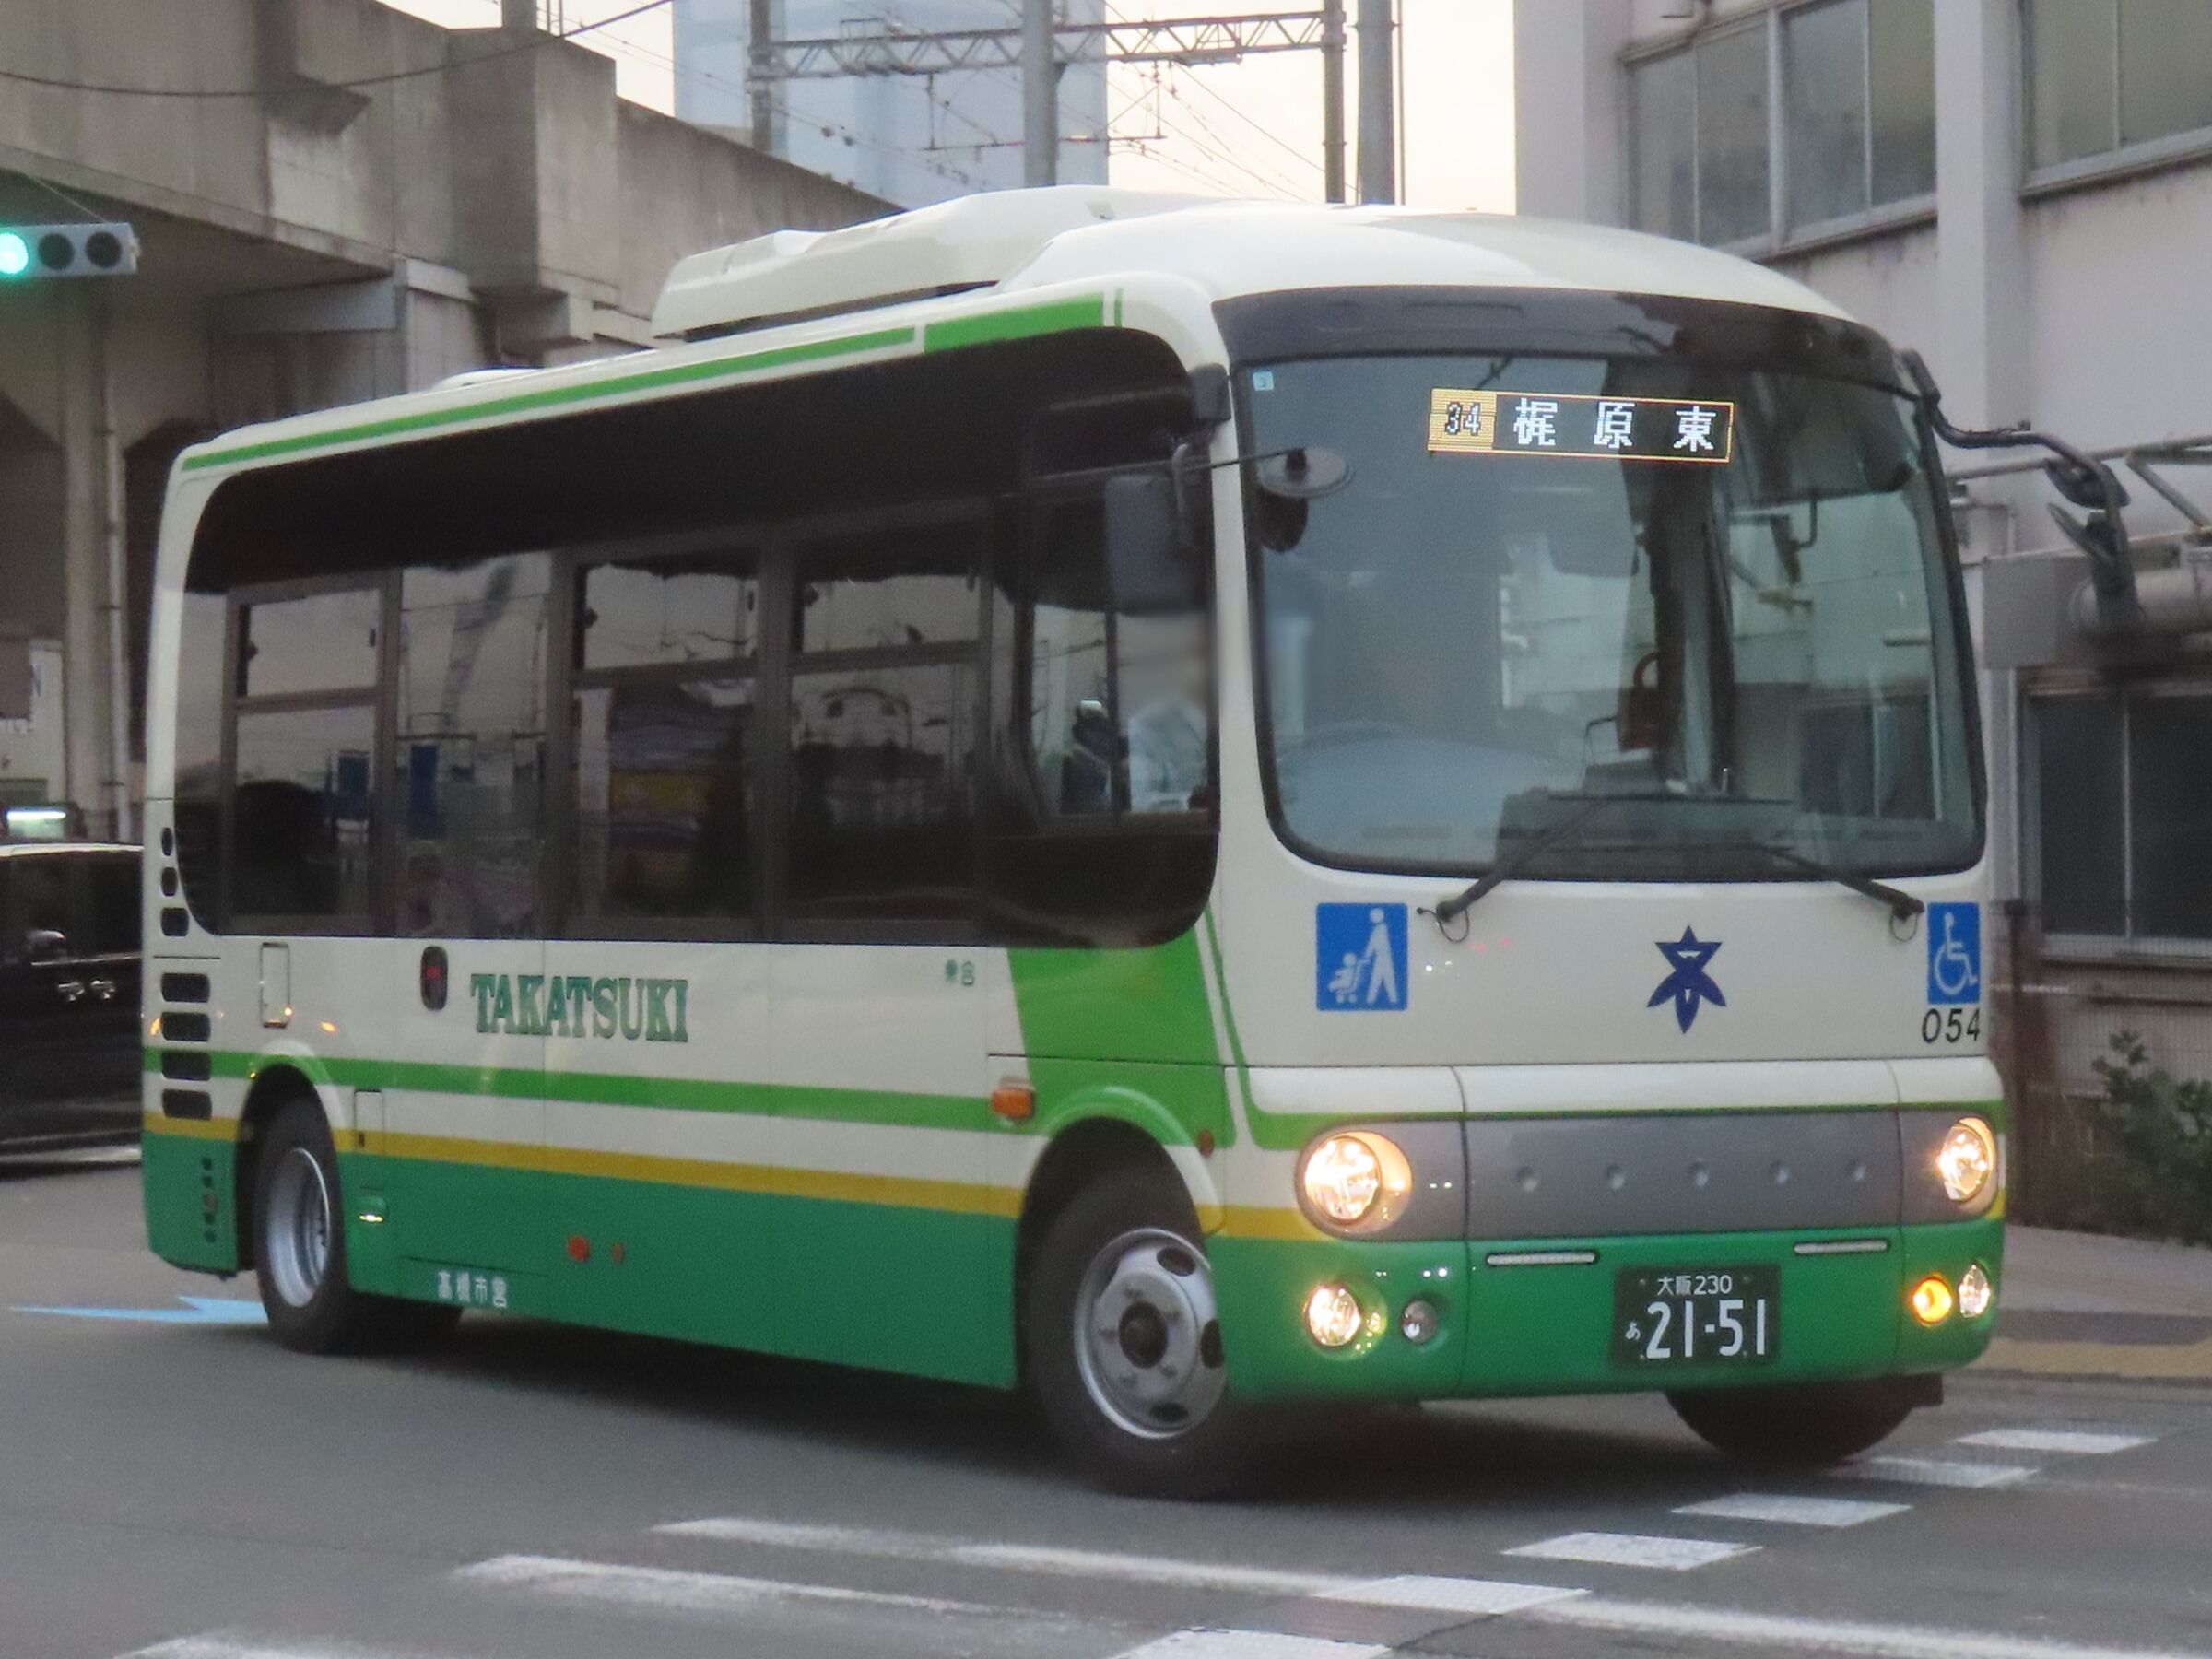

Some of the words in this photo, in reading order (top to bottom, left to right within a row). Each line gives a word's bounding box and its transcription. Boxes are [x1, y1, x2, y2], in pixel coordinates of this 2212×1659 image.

[1444, 402, 1481, 436] 34
[1512, 397, 1717, 452] 梶原東
[470, 973, 688, 1042] TAKATSUKI
[1922, 1007, 1981, 1043] 054
[1625, 1319, 1641, 1341] あ
[1645, 1298, 1766, 1359] 21-51
